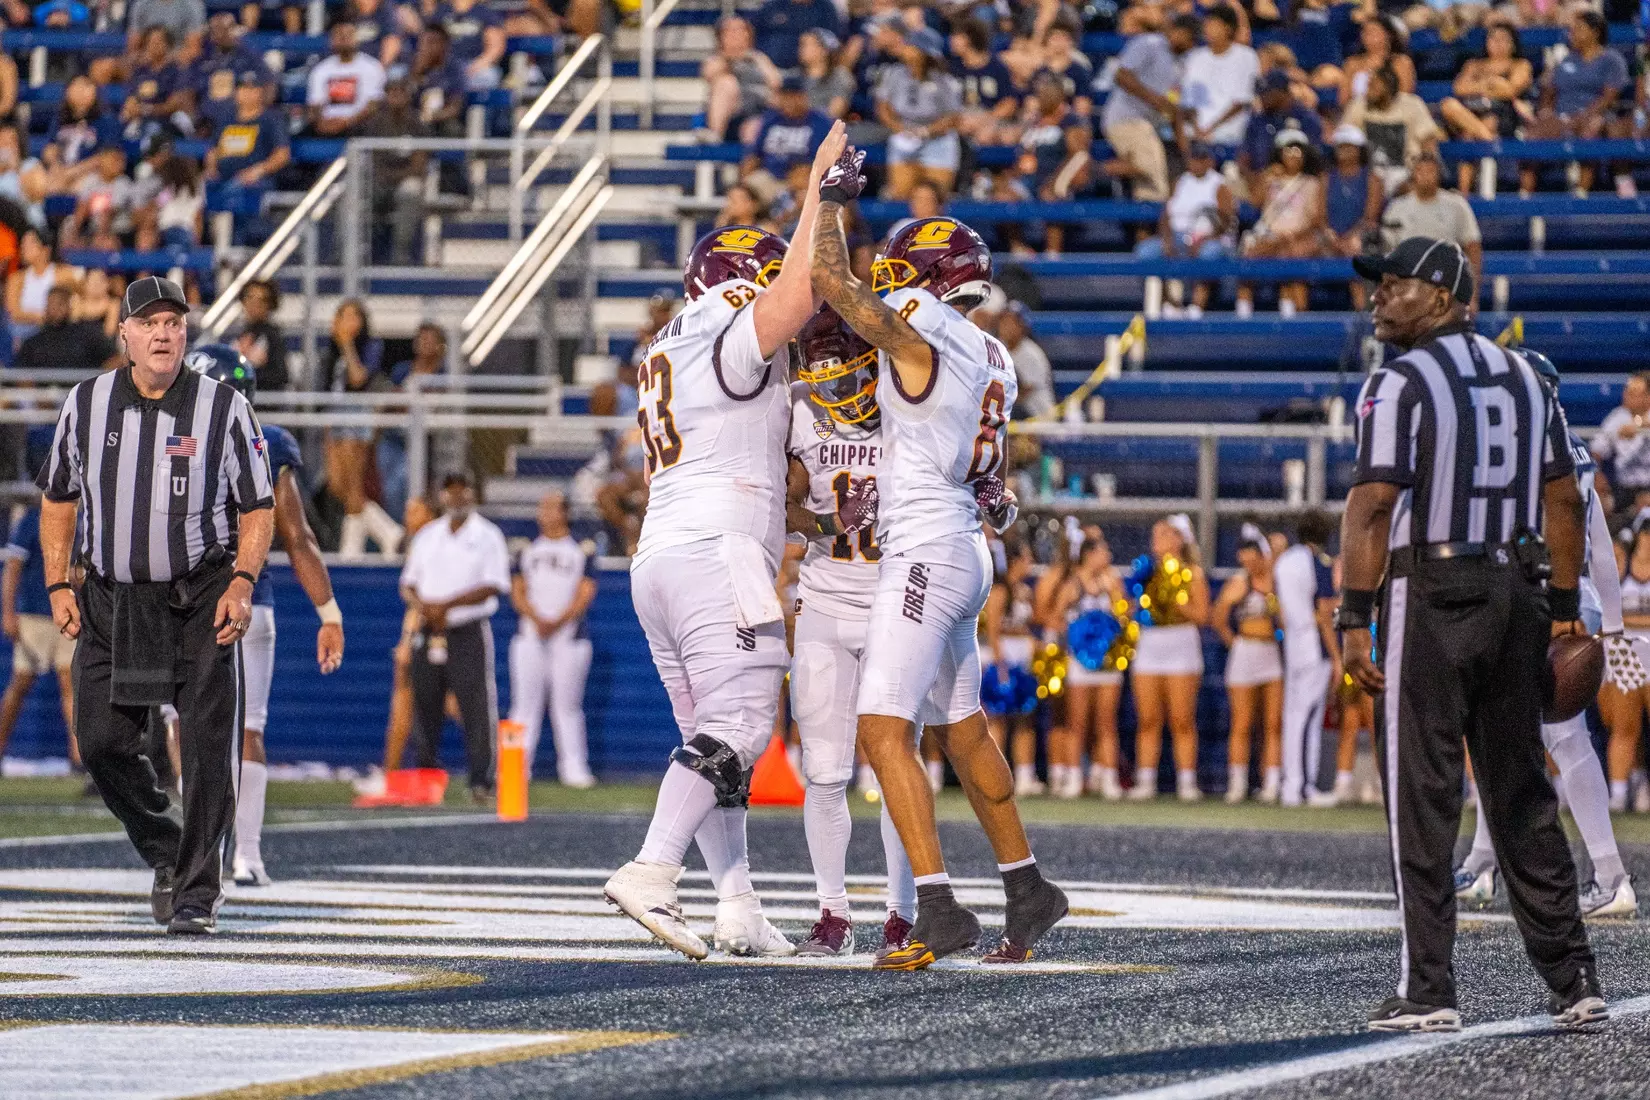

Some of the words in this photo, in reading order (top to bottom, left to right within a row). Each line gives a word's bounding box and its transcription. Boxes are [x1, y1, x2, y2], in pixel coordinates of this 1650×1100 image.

[722, 285, 757, 311] 63
[900, 298, 920, 321] 8
[637, 351, 684, 476] 63
[106, 432, 119, 447] S
[963, 379, 1006, 484] 8
[1468, 385, 1519, 488] B
[820, 444, 883, 466] CHIPPE
[172, 476, 187, 497] U
[908, 563, 932, 590] UP!
[903, 586, 926, 624] FIRE
